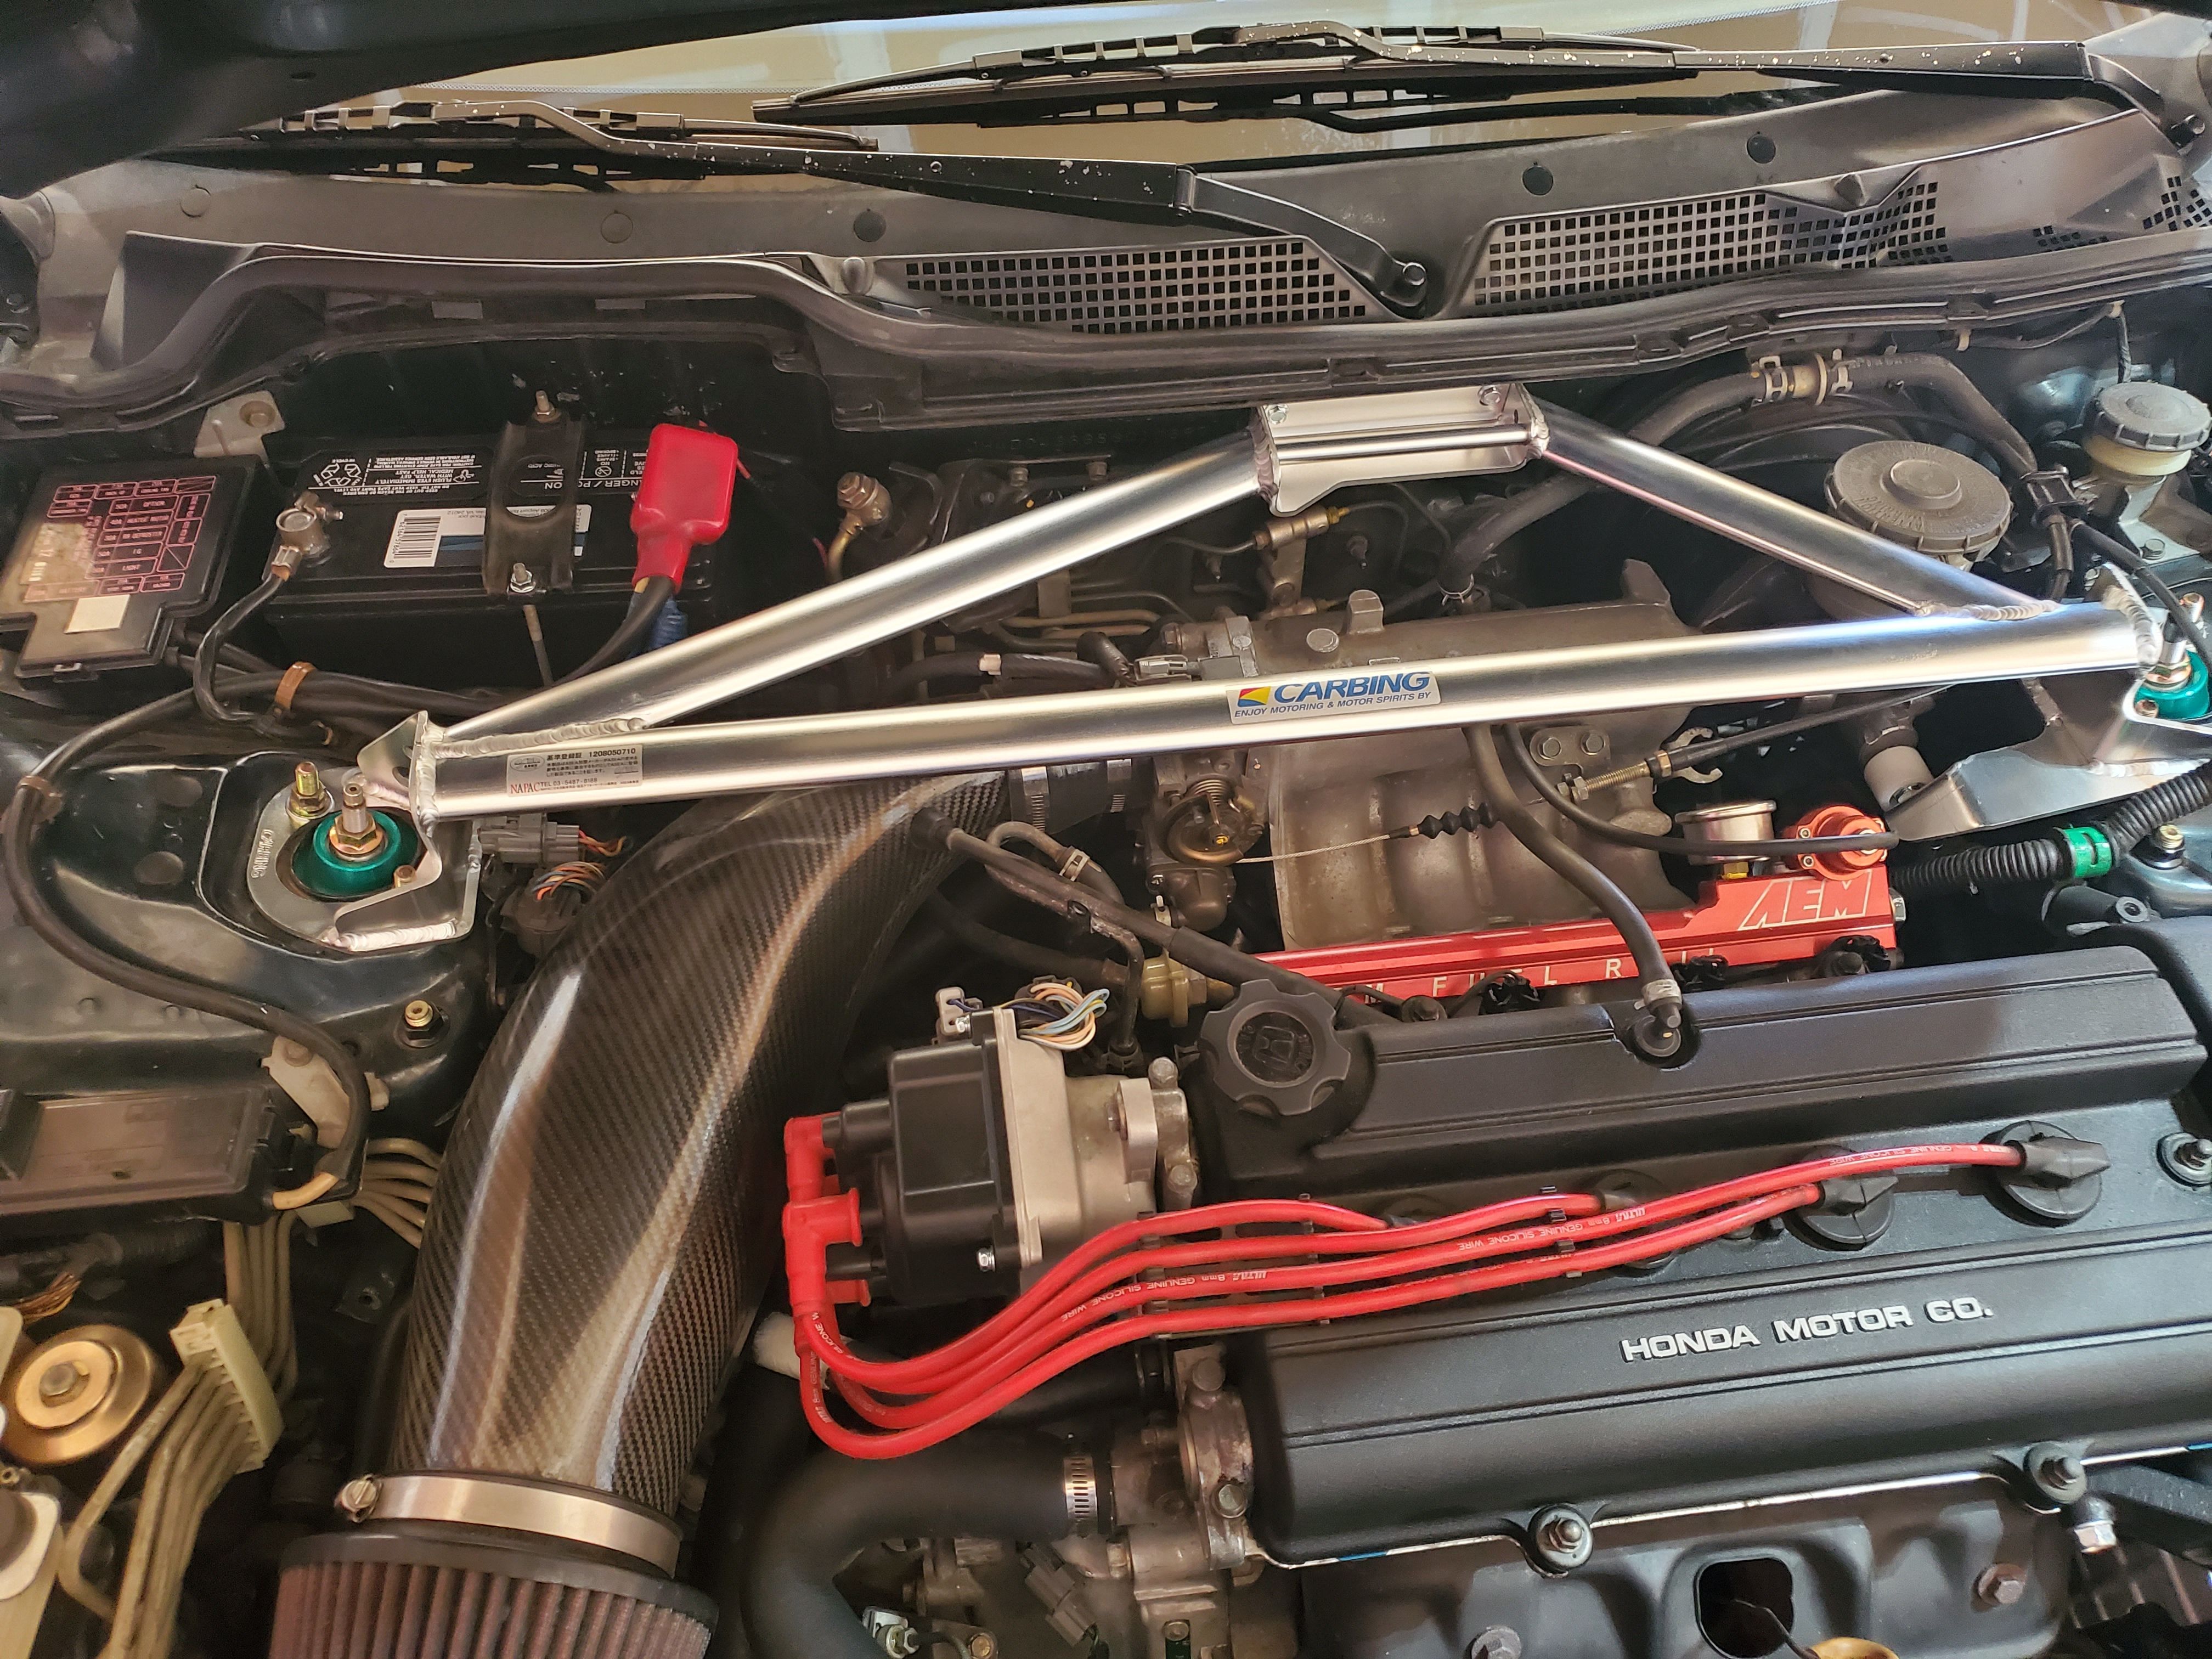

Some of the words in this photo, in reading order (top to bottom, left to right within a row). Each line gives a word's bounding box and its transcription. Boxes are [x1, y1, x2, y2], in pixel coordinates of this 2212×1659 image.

[397, 522, 406, 537] 62164
[1274, 672, 1431, 703] CARBING
[1234, 708, 1267, 718] ENJOY
[1270, 702, 1323, 714] MOTORING
[1338, 698, 1372, 706] MOTOR
[1376, 693, 1415, 703] SPIRITS
[1418, 691, 1431, 699] BY
[589, 748, 636, 758] 1208050710
[511, 782, 540, 794] NAPAC
[251, 829, 274, 879] CARBING
[1737, 868, 1872, 931] AEM
[1860, 1149, 1905, 1160] SILICONE
[1911, 1145, 1952, 1153] GENUINE
[1830, 1155, 1855, 1166] WIRE
[1588, 1217, 1611, 1227] 8mm
[1539, 1223, 1583, 1237] GENUINE
[1458, 1239, 1483, 1251] WIRE
[1487, 1232, 1535, 1246] SILICONE
[1146, 1277, 1196, 1290] GENUINE
[1092, 1284, 1141, 1307] SILICONE
[1060, 1304, 1087, 1323] WIRE
[1622, 1324, 1760, 1362] HONDA
[1773, 1306, 1914, 1344] MOTOR
[1926, 1297, 1993, 1324] CO.
